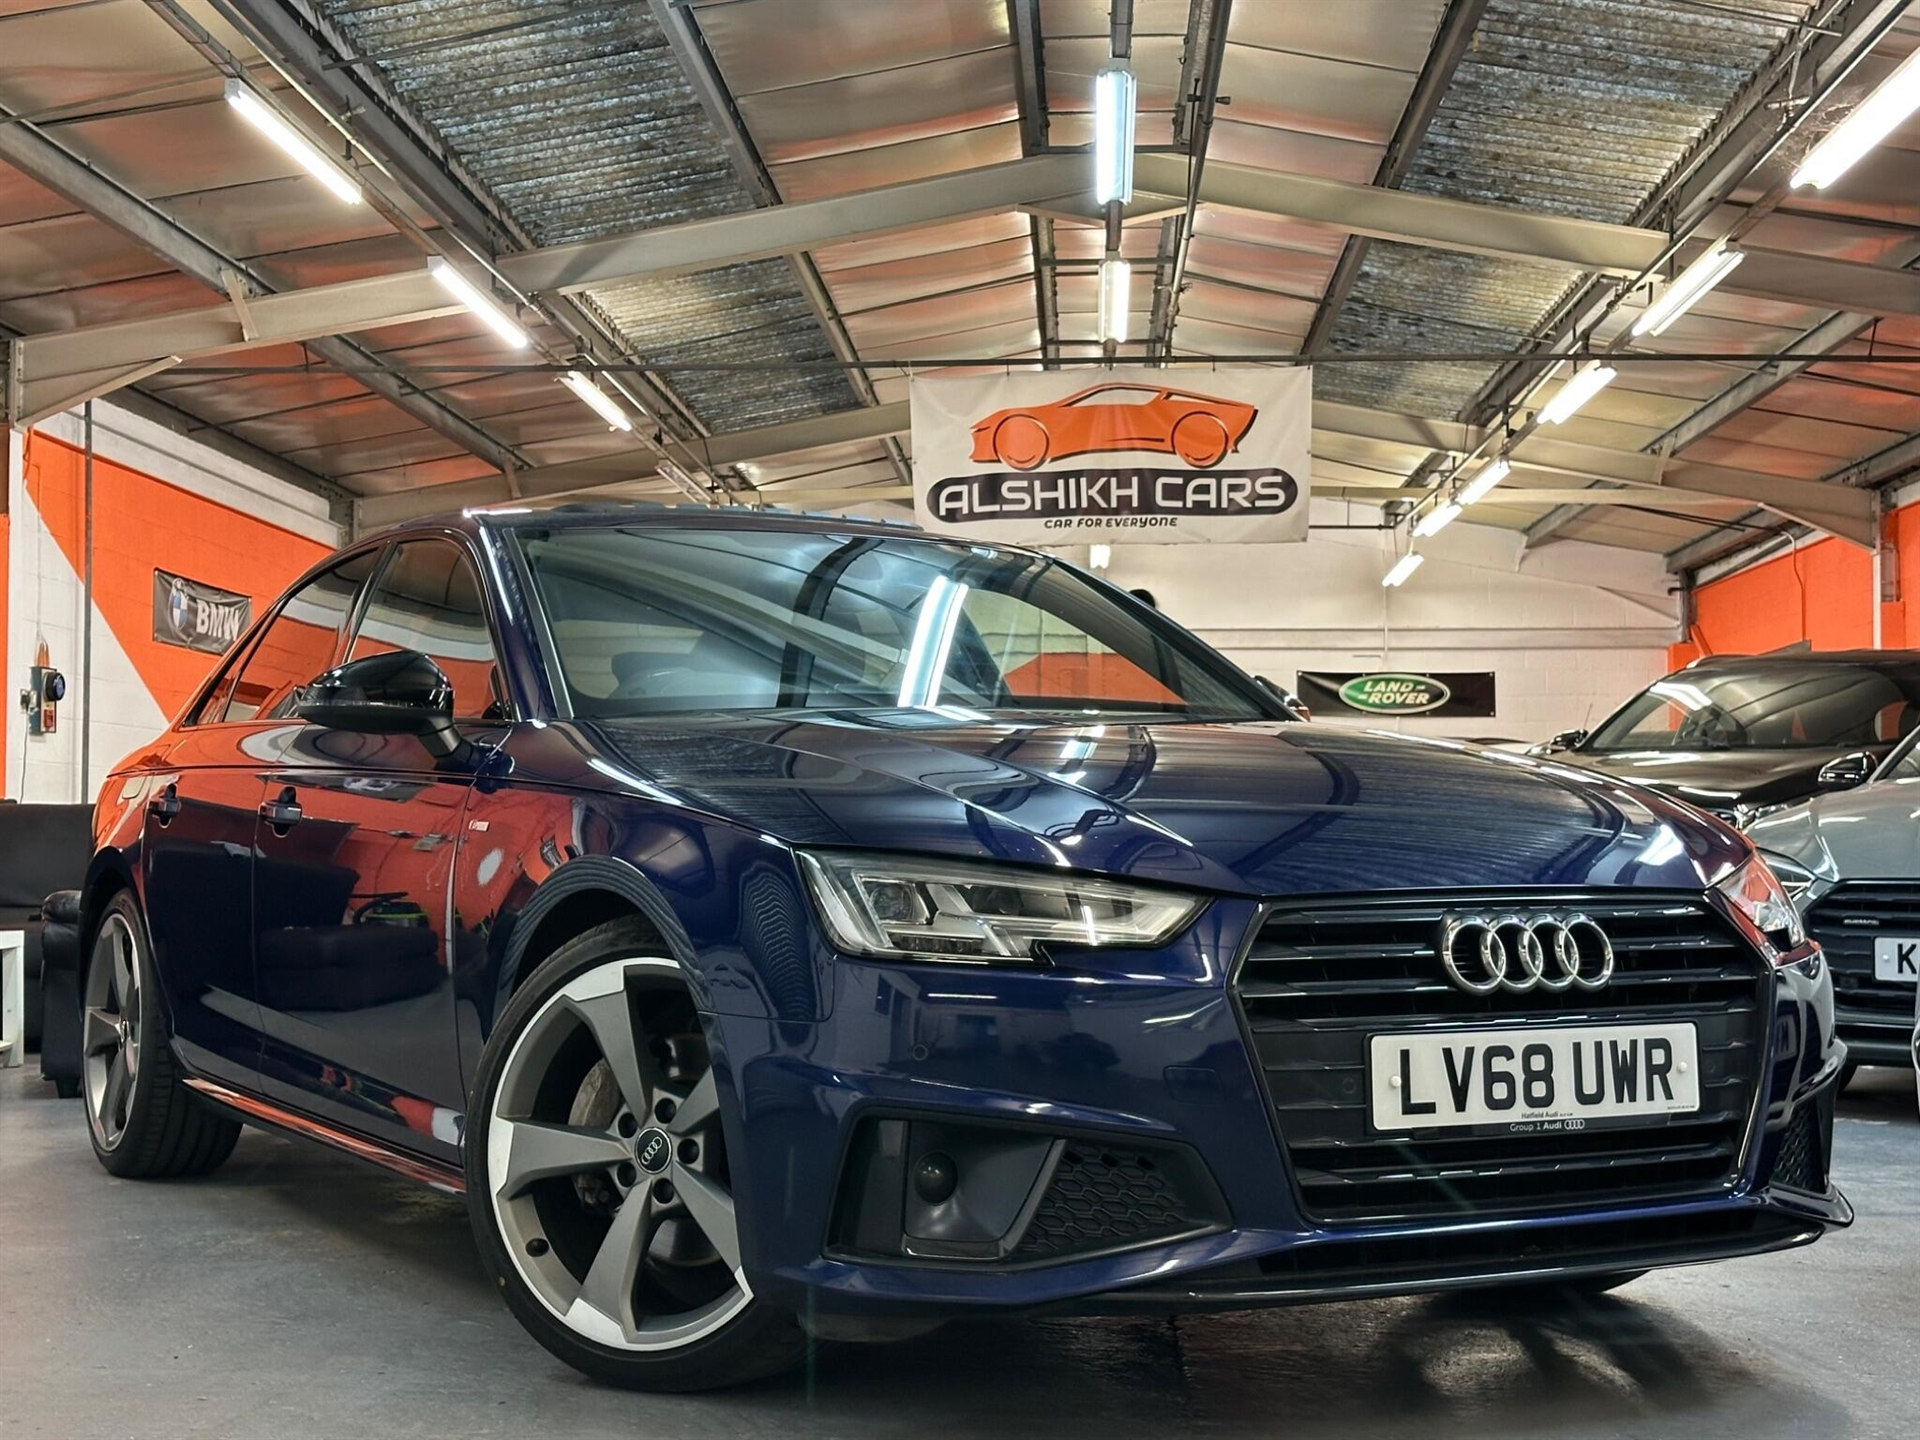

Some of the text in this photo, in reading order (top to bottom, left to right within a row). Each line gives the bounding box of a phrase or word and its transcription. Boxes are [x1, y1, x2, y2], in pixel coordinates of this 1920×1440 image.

[938, 475, 1287, 517] ALSHIKH CARS
[1044, 516, 1178, 529] CAR FOR EVERYONE
[196, 598, 240, 642] BMW
[1363, 680, 1415, 692] LAND
[1368, 692, 1430, 704] ROVER
[1400, 1037, 1675, 1115] LV68 UWR
[1545, 1111, 1559, 1119] Audi
[1510, 1123, 1534, 1132] Group
[1543, 1121, 1562, 1130] Audi
